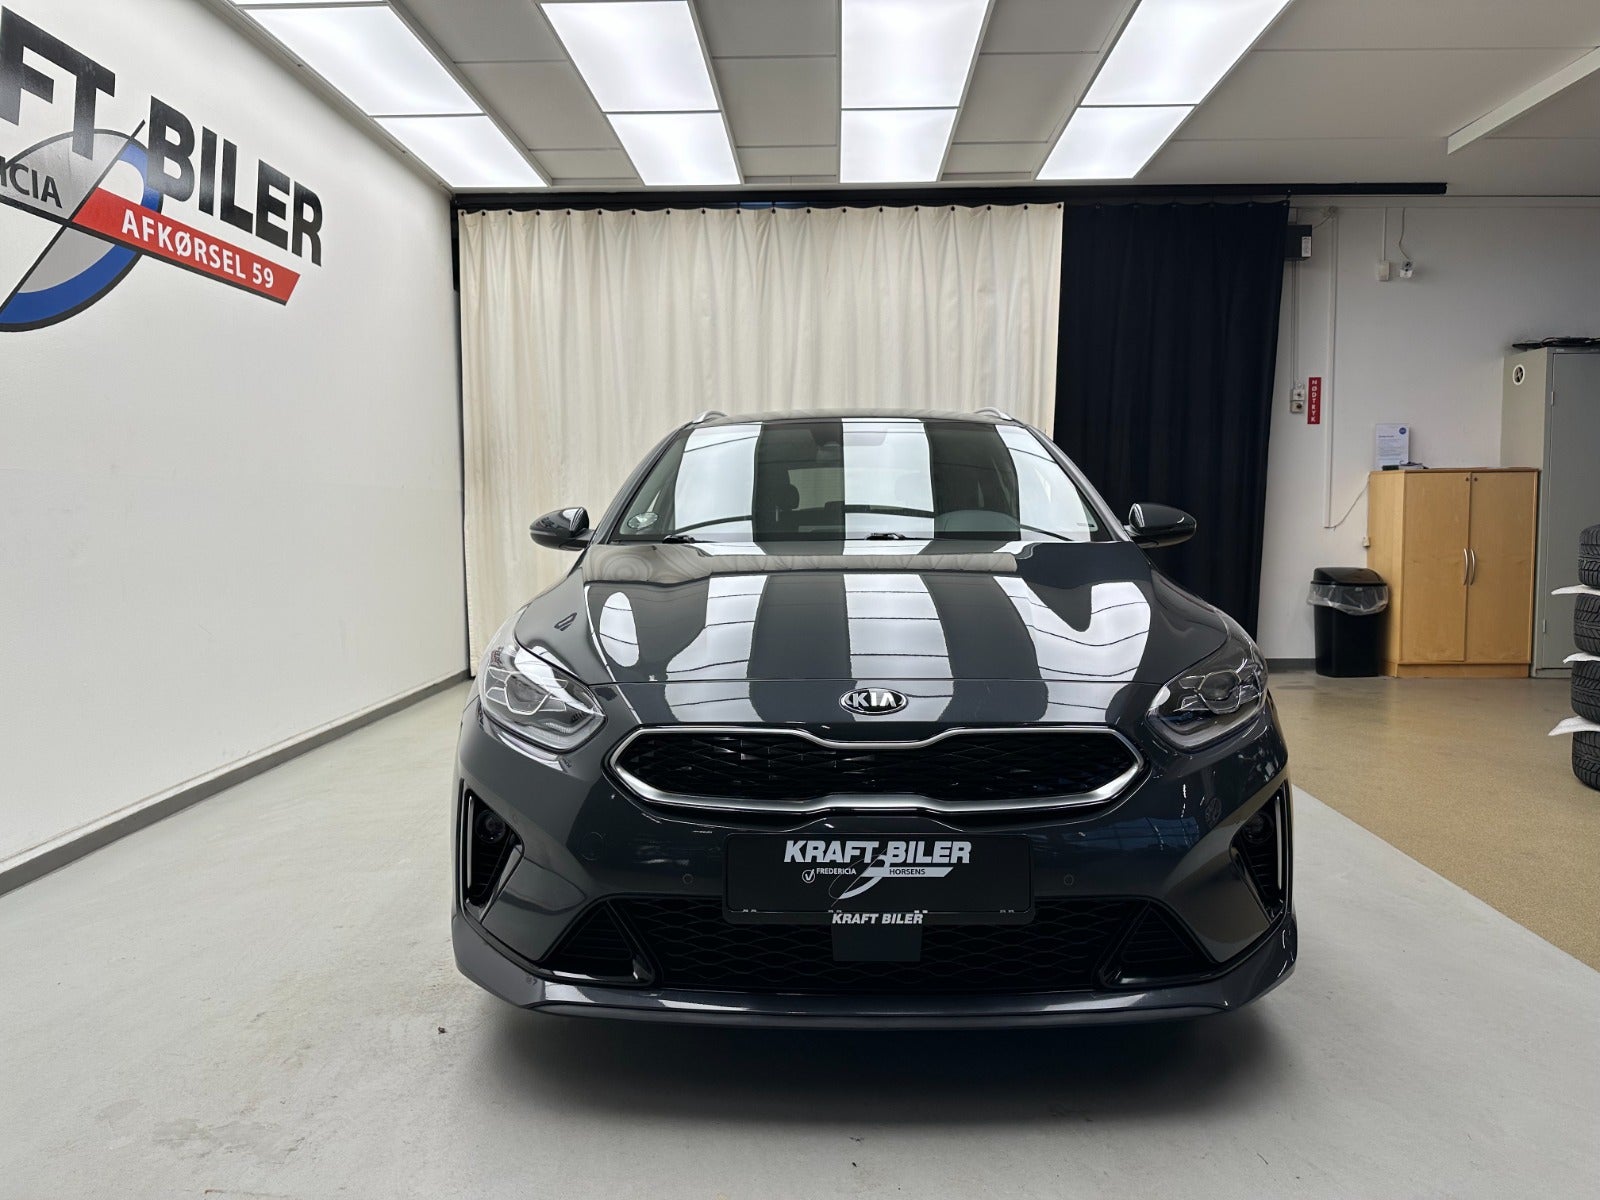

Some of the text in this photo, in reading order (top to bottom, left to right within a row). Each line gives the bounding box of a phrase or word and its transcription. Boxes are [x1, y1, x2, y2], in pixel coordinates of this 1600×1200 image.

[147, 95, 323, 267] BILER
[121, 209, 274, 289] AFKØRSEL 59
[852, 692, 897, 707] KIA
[784, 840, 972, 864] KRAFT BILER
[816, 867, 857, 875] FREDERICIA
[832, 913, 924, 924] KRAFT BILER
